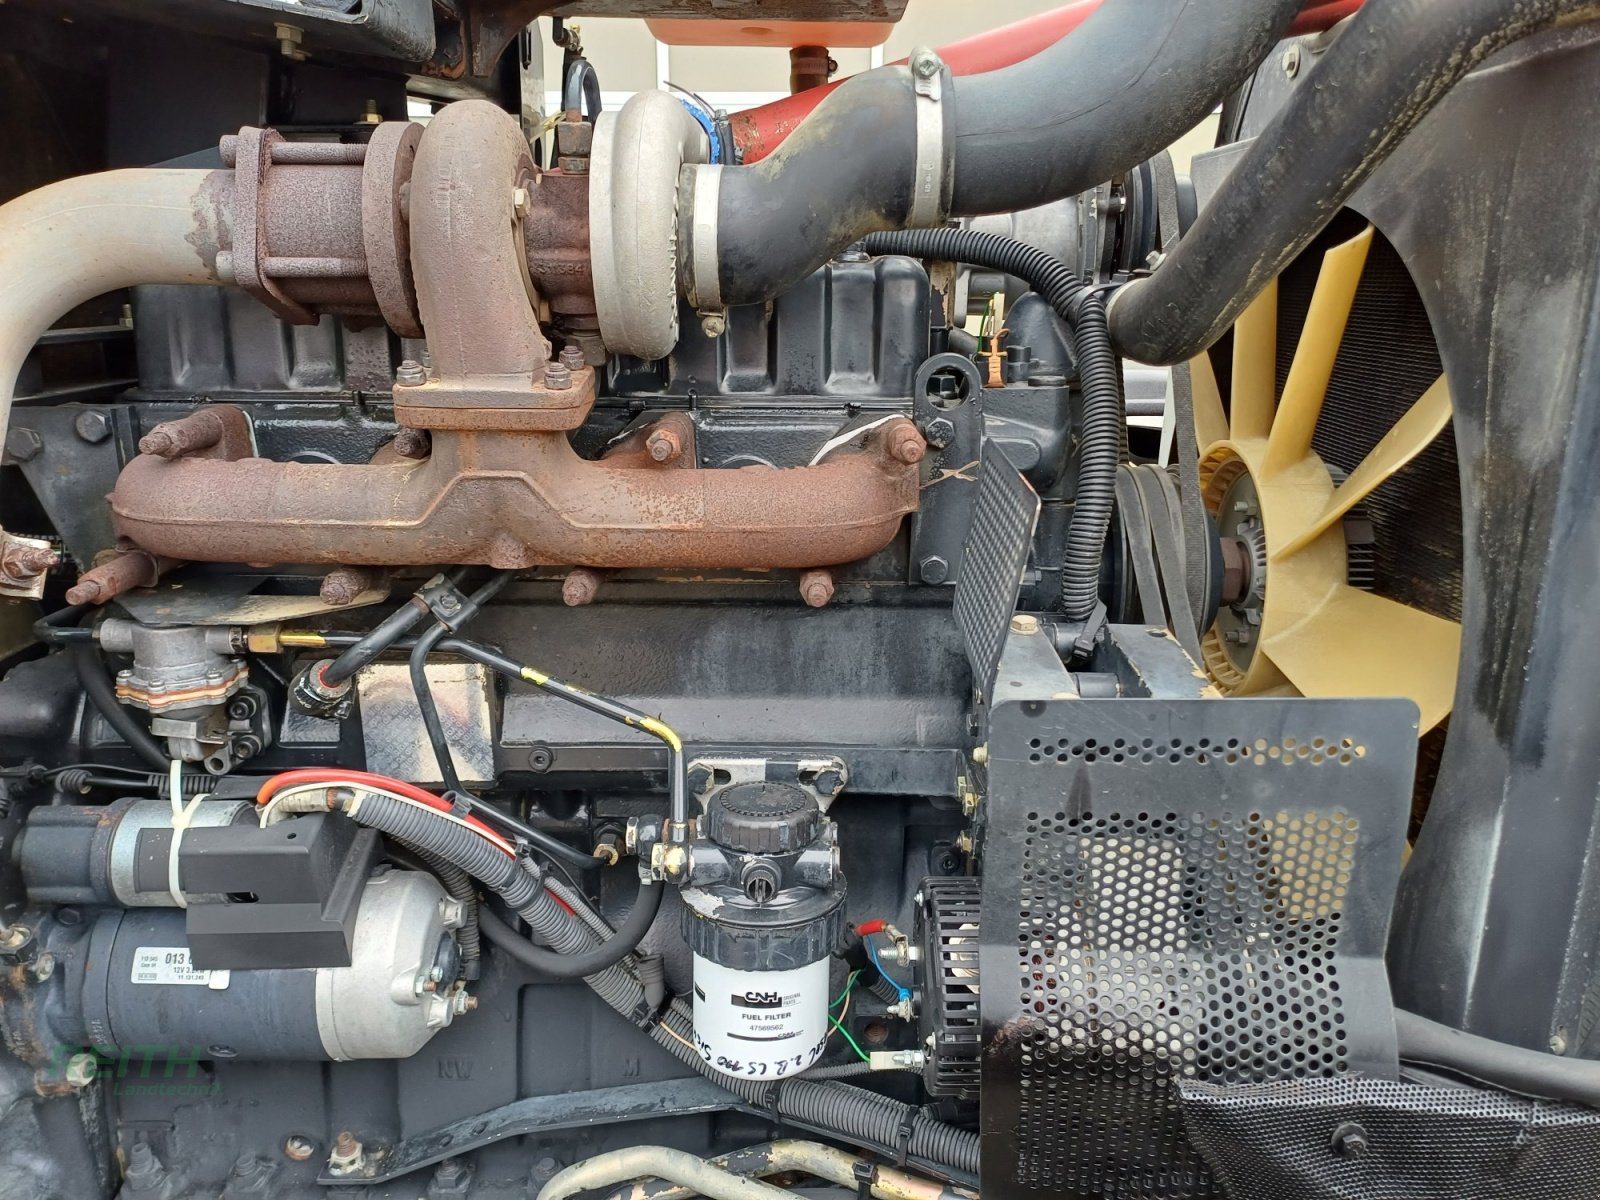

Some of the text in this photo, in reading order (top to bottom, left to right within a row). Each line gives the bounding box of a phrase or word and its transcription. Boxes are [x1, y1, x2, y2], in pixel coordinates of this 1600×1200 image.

[165, 953, 185, 965] 013
[173, 966, 185, 974] 12V
[745, 991, 778, 1003] CNH
[742, 1012, 792, 1021] FUEL FILTER
